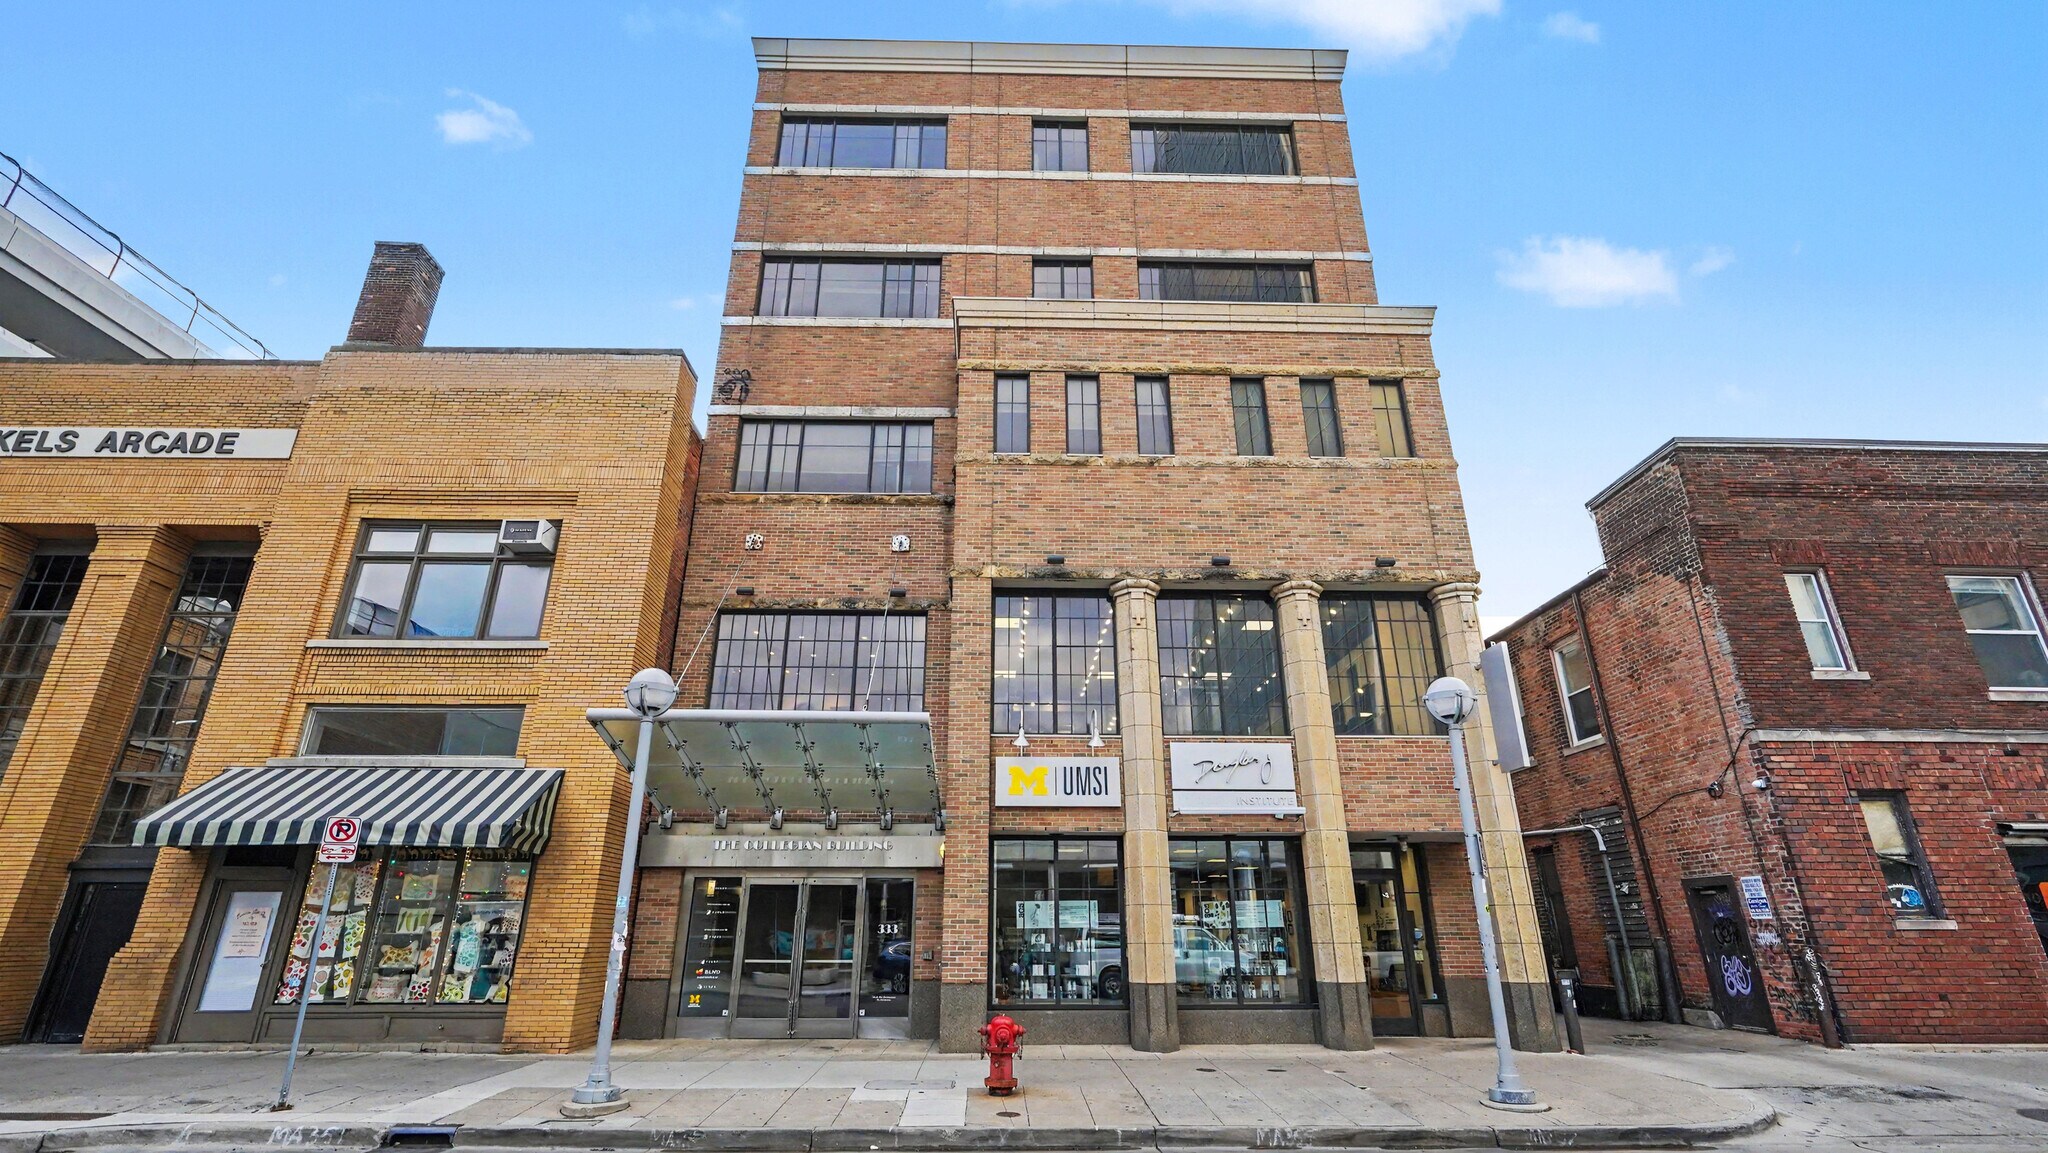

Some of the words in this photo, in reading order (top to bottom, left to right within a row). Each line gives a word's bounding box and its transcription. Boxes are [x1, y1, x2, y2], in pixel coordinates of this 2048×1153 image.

[0, 430, 79, 453] KELS
[95, 431, 240, 454] ARCADE
[1008, 766, 1049, 796] M
[1063, 766, 1109, 796] UMSI
[1236, 797, 1296, 806] INSTITUTE
[714, 840, 740, 851] THE
[743, 840, 823, 851] COLLEGIAN
[826, 840, 894, 851] BUILDING
[877, 923, 899, 934] 333
